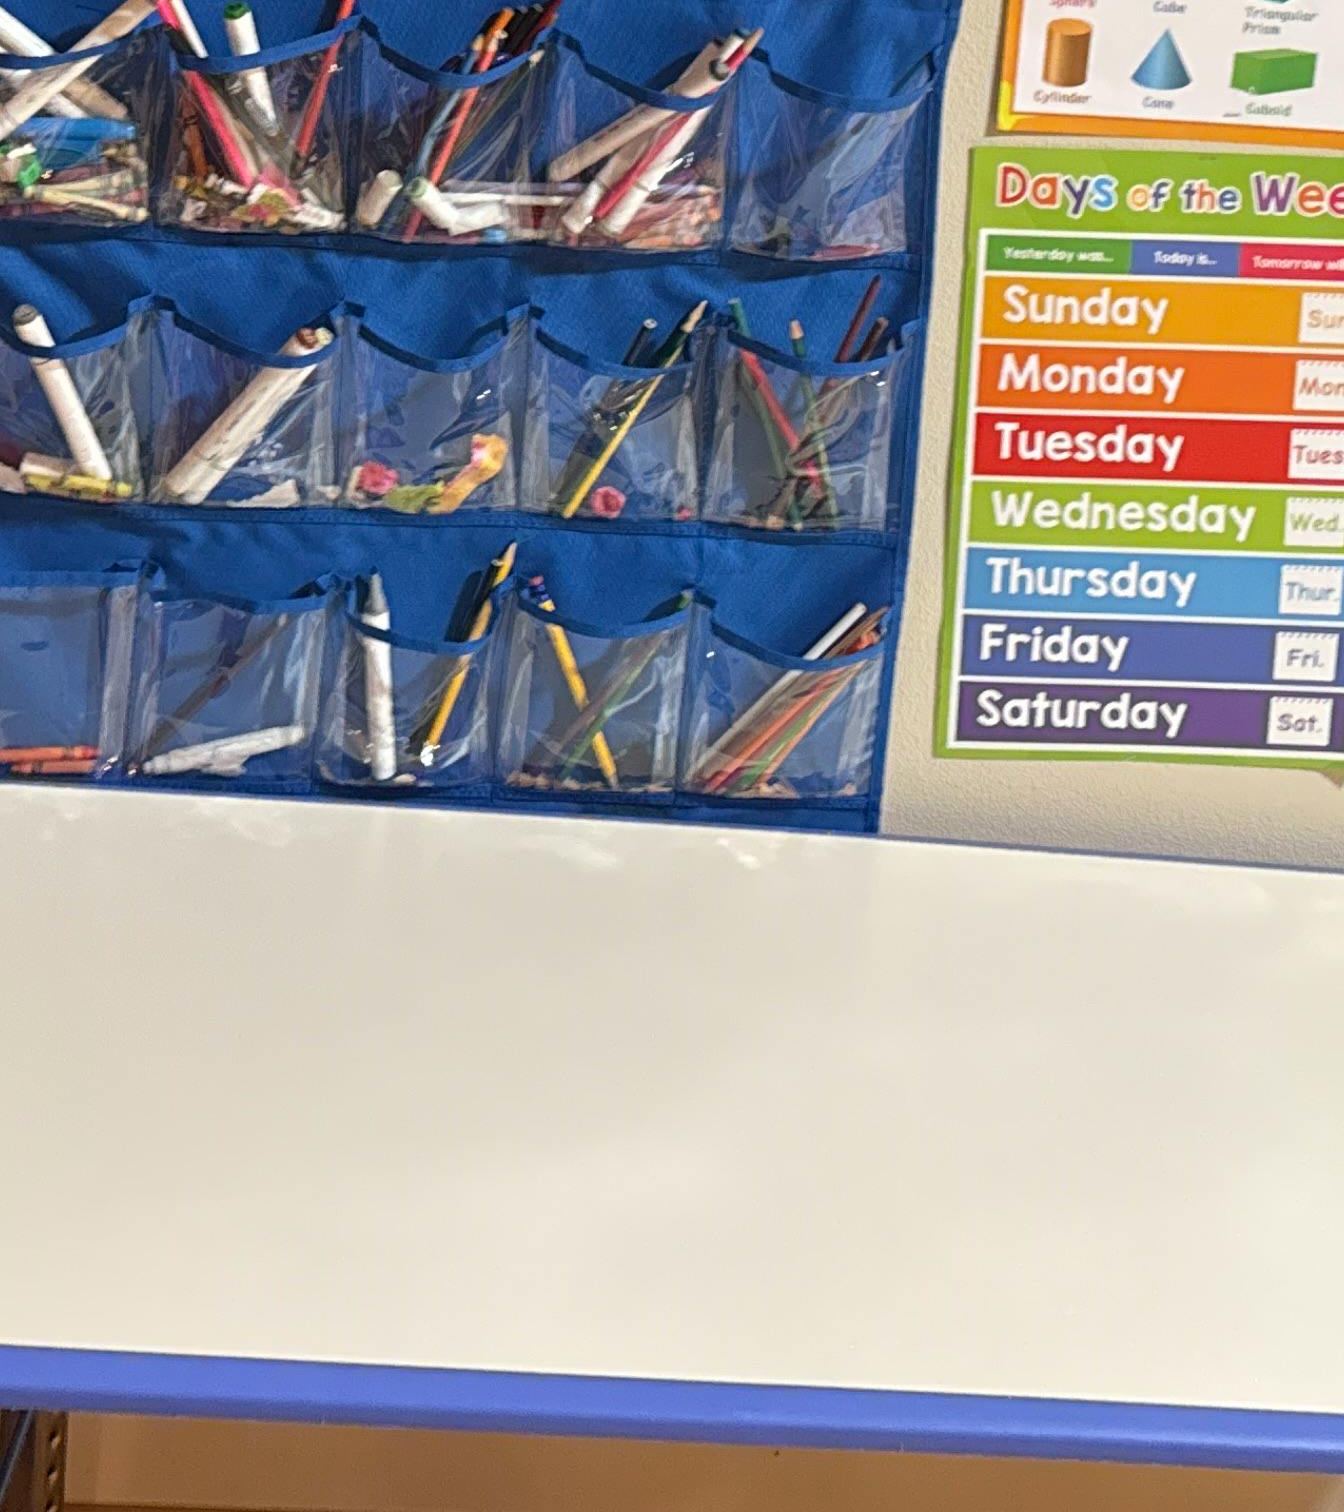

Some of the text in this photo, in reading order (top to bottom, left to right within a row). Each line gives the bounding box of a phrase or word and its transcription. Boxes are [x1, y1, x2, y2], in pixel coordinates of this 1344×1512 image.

[1244, 6, 1319, 23] Triangular
[1033, 90, 1092, 105] Cylinder
[996, 163, 1118, 216] Days
[1128, 182, 1174, 209] of
[1180, 181, 1241, 213] the
[1003, 246, 1074, 264] Yesterday
[1153, 250, 1195, 267] Today
[1252, 255, 1323, 271] Tomorrow
[1002, 283, 1170, 334] Sunday
[997, 352, 1186, 404] Monday
[994, 422, 1185, 473] Tuesday
[990, 490, 1256, 544] Wednesday
[985, 557, 1197, 608] Thursday
[1284, 581, 1340, 603] Thur.
[979, 623, 1130, 672] Friday
[1285, 647, 1324, 669] Fri.
[975, 689, 1188, 740] Saturday
[1276, 713, 1324, 734] Sat.
